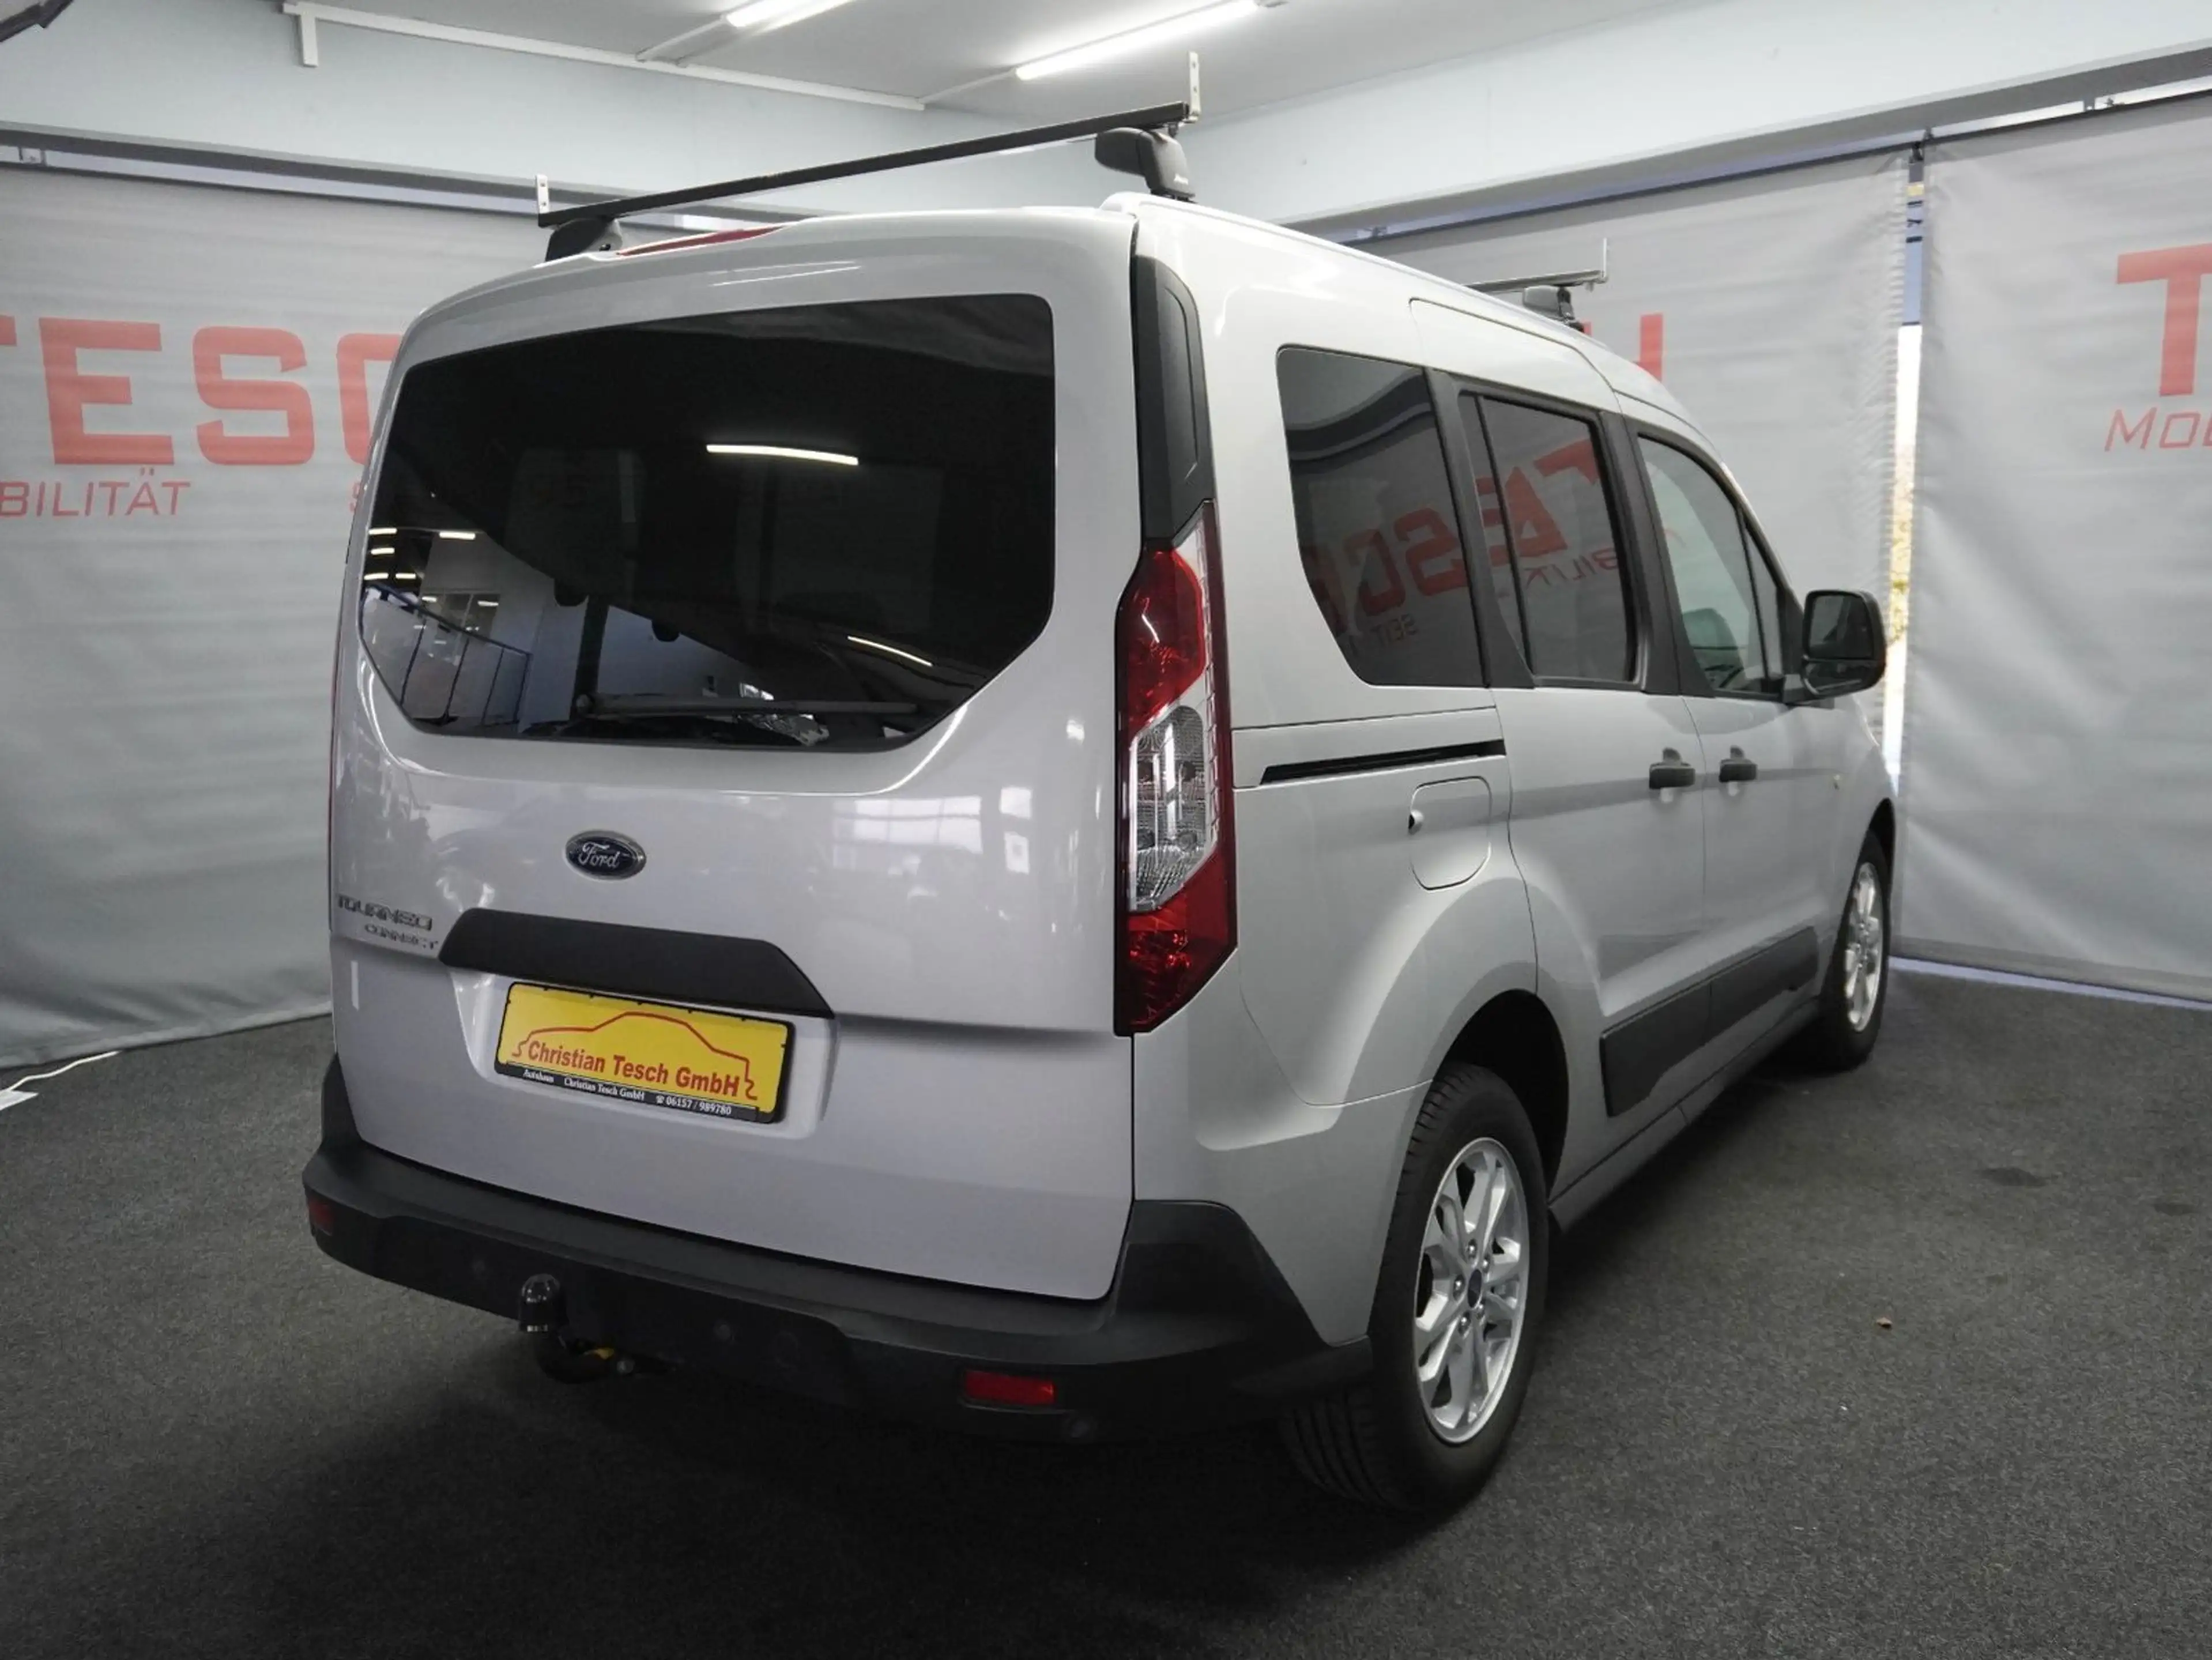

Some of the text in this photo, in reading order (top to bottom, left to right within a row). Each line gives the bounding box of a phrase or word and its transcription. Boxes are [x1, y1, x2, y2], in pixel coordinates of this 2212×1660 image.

[578, 842, 621, 868] Ford
[338, 894, 432, 931] TOURNEO
[364, 923, 439, 950] CONNECT
[528, 1040, 740, 1097] Christian Tesch GmbH
[564, 1077, 596, 1092] Christian
[597, 1082, 618, 1096] Tesch
[620, 1088, 645, 1101] GmbH
[666, 1096, 692, 1110] 06157
[699, 1101, 732, 1115] 989780
